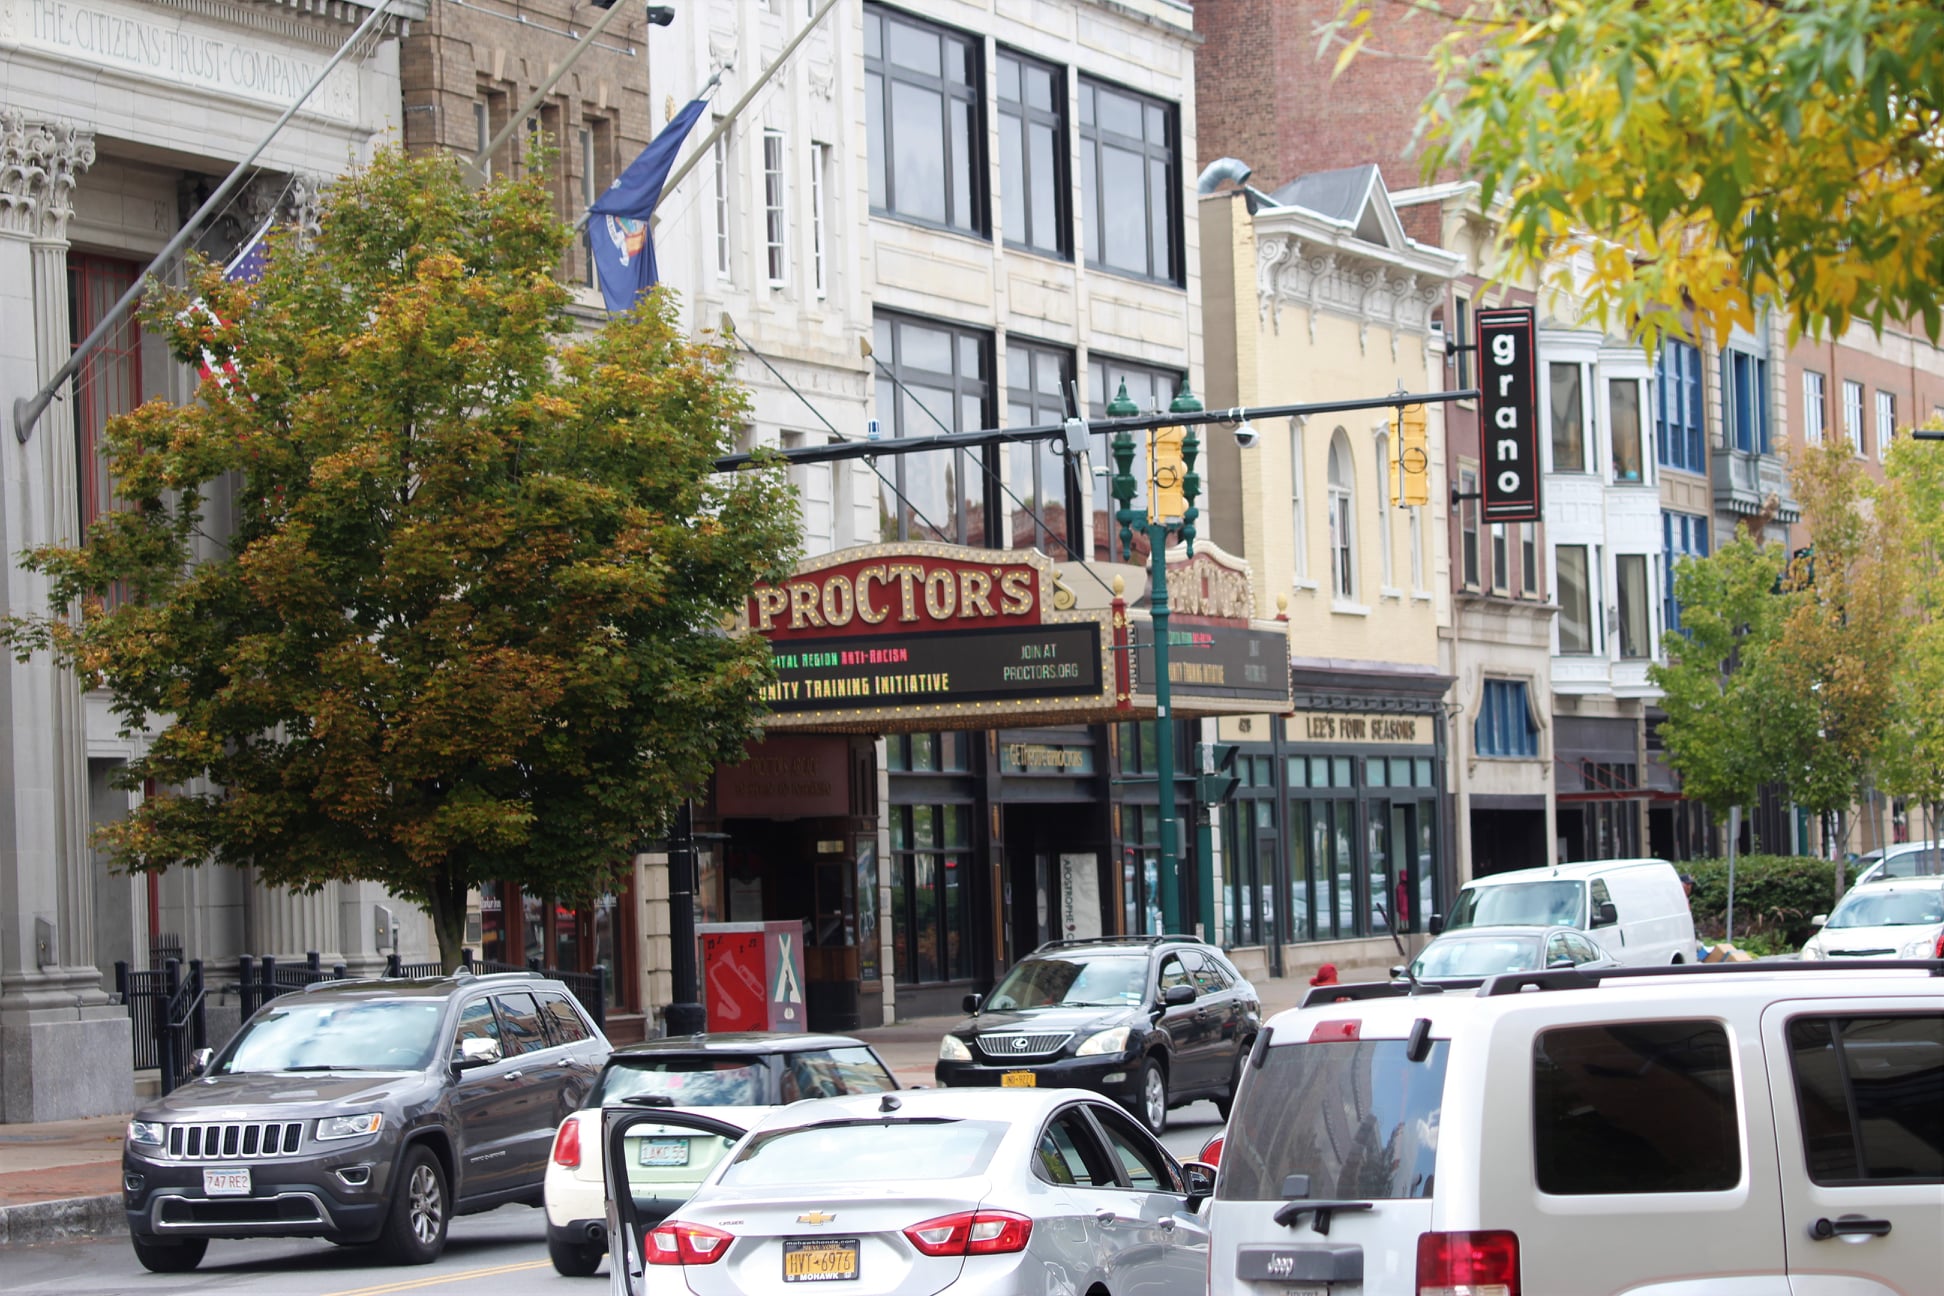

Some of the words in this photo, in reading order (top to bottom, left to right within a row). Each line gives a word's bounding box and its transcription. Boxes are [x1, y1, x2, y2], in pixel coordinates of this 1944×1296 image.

[32, 0, 71, 46] THE
[75, 8, 161, 67] CITIZENS
[164, 29, 224, 83] TRUST
[229, 46, 316, 103] COMPANY
[1491, 333, 1521, 494] grano
[751, 563, 1034, 632] PROCTOR'S
[773, 654, 799, 669] ITAL
[801, 651, 838, 668] REGION
[841, 648, 908, 666] ANTI-RACISM
[1020, 644, 1041, 660] JOIN
[1043, 643, 1057, 659] AT
[1003, 662, 1079, 681] PROCTORS.ORG
[758, 681, 800, 702] UNITY
[805, 676, 870, 699] TRAINING
[874, 672, 950, 695] INITIATIVE
[1306, 715, 1335, 740] LEE'S
[1340, 717, 1366, 740] FOUR
[1371, 718, 1416, 741] SEASONS
[1062, 858, 1074, 924] APOSTROPHE
[207, 1175, 227, 1189] 747
[800, 1272, 839, 1281] MOHAWK
[1267, 1252, 1294, 1277] Jeep
